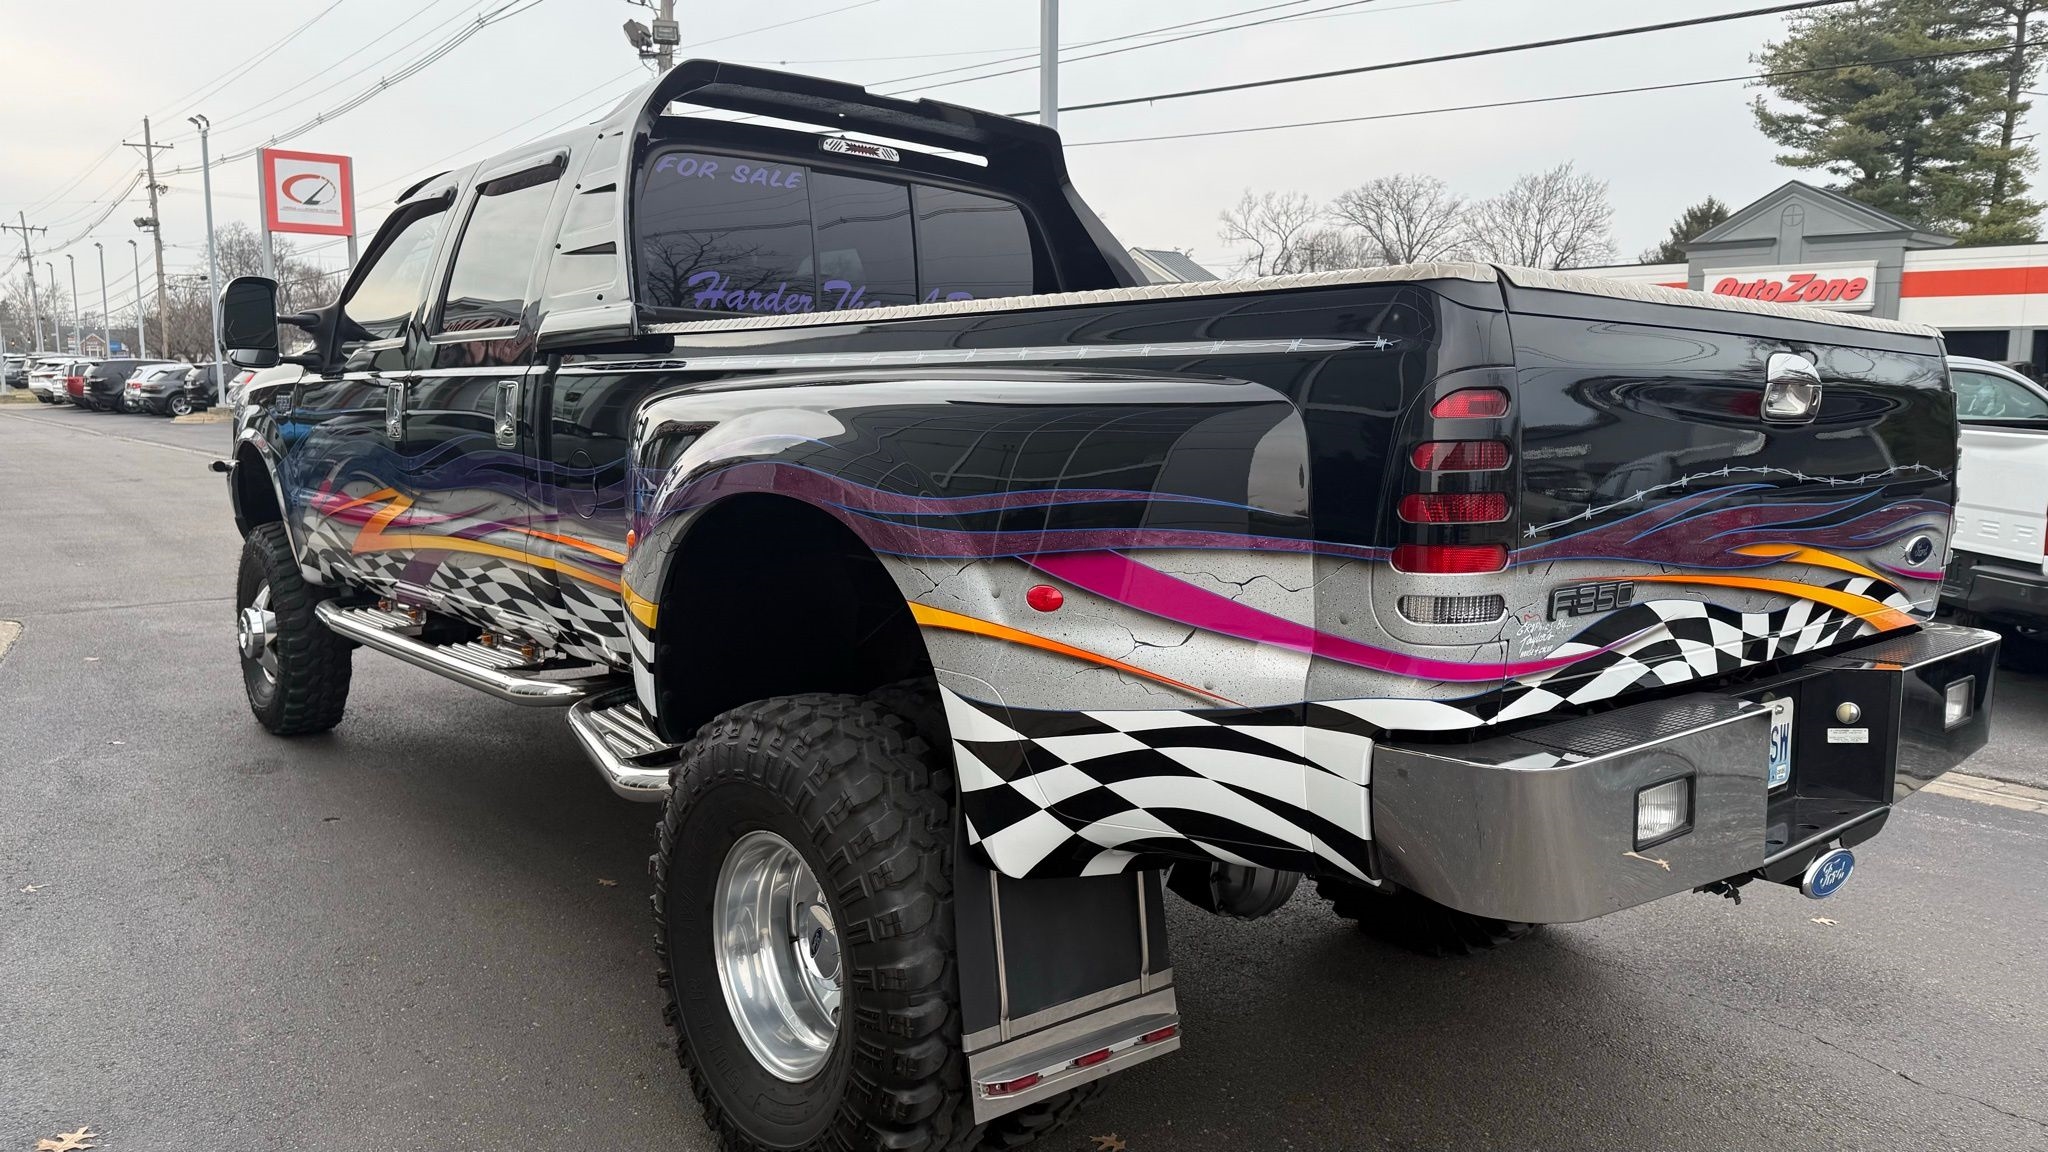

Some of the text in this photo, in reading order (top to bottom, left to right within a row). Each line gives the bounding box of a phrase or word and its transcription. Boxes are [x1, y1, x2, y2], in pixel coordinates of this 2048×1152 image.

[656, 156, 802, 189] FOR SALE
[688, 271, 815, 312] Harder
[1713, 273, 1868, 302] AutoZone
[1819, 858, 1846, 889] Ford
